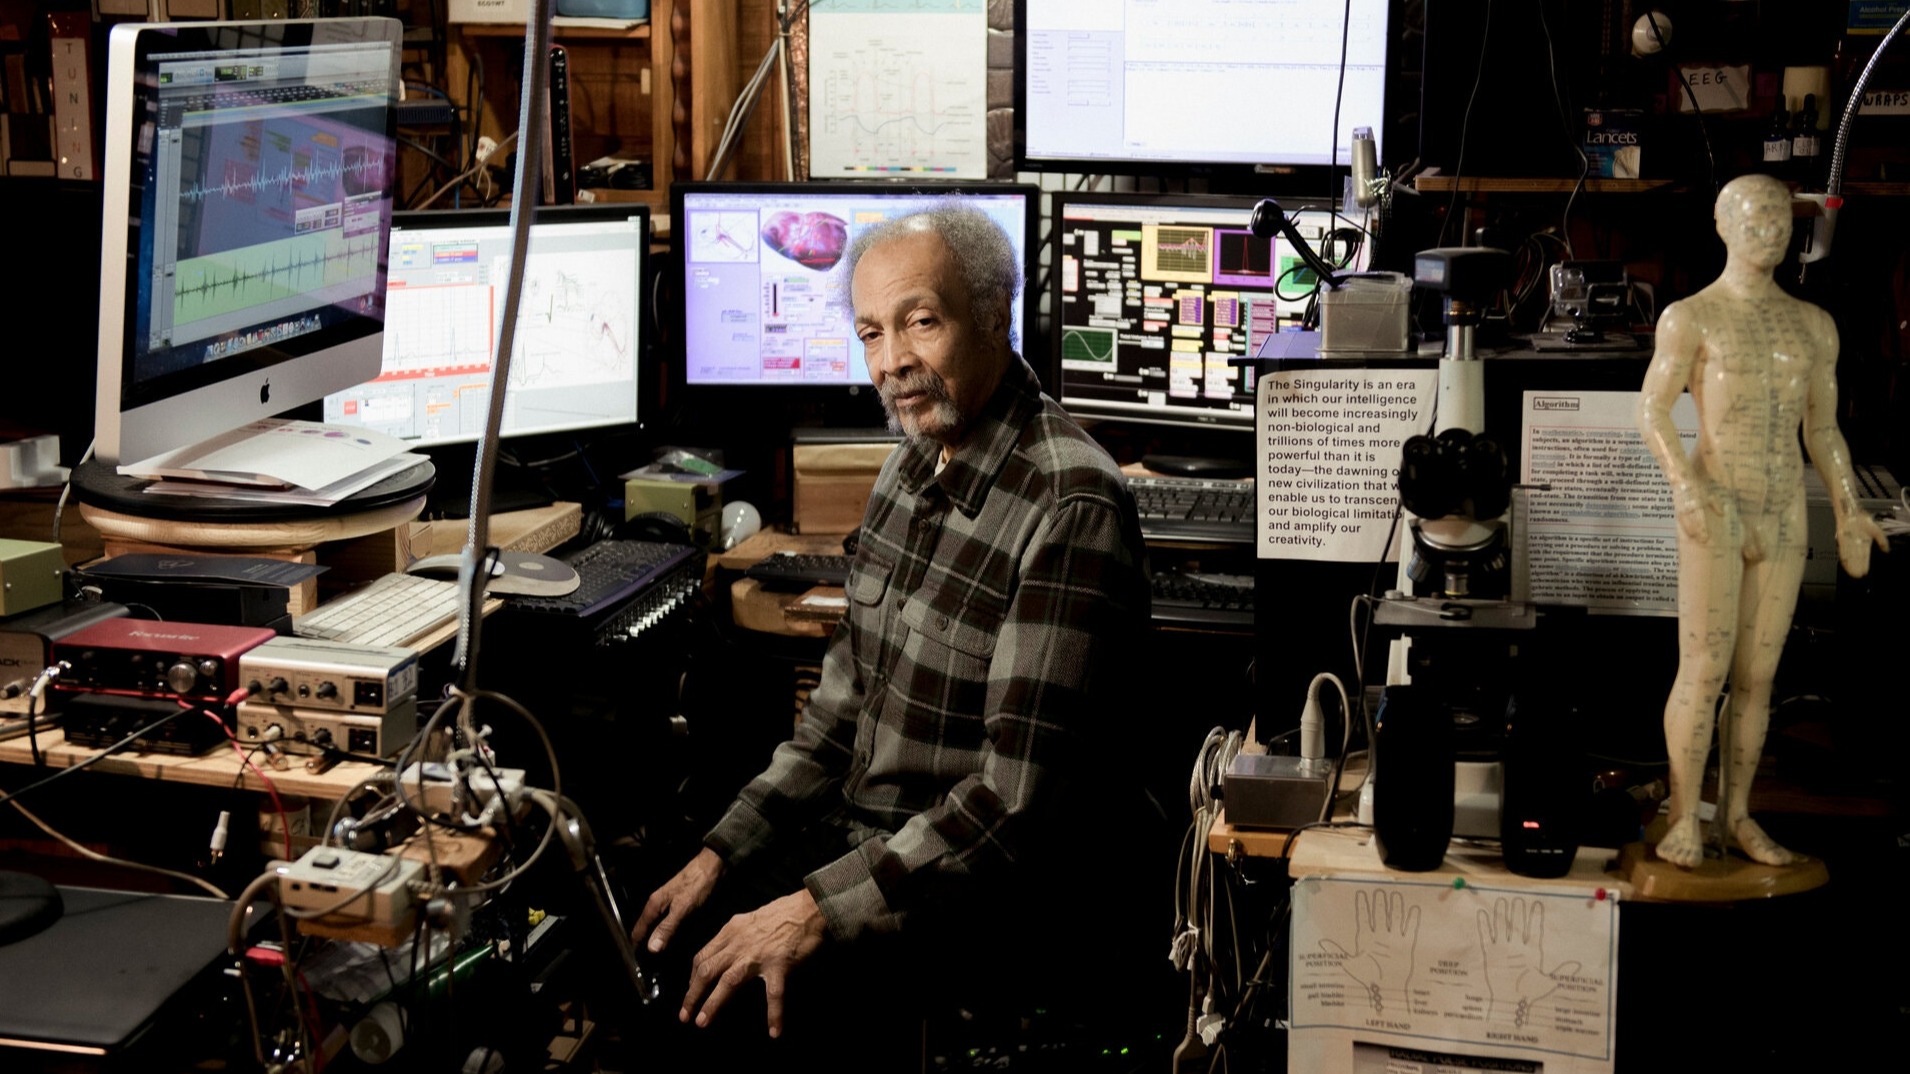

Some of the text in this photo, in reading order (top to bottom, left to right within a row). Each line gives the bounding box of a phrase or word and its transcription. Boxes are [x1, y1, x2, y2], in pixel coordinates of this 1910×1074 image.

[1689, 71, 1726, 86] EEG
[1864, 94, 1908, 106] WRAPS
[64, 42, 83, 178] TUNING
[1587, 130, 1638, 144] Lancets
[1268, 380, 1289, 390] The
[1294, 379, 1359, 392] Singularity
[1364, 379, 1373, 389] is
[1268, 395, 1278, 403] in
[1282, 393, 1317, 403] which
[1347, 394, 1416, 406] intelligence
[1536, 400, 1579, 410] Algorithm
[1268, 408, 1418, 421] will become increasingly
[1268, 422, 1380, 434] non-biological and
[1268, 436, 1400, 447] trillions of times more
[1269, 450, 1375, 462] powerful than it is
[1337, 466, 1387, 478] dawning
[1269, 480, 1292, 488] new
[1296, 479, 1359, 490] civilization
[1364, 481, 1387, 490] that
[1269, 493, 1307, 502] enable
[1329, 495, 1340, 503] to
[1345, 495, 1398, 505] transcen
[1292, 507, 1349, 520] biological
[1354, 508, 1403, 519] limitatio
[1269, 521, 1361, 534] and amplify our
[1269, 535, 1325, 548] creativity.
[1366, 1019, 1411, 1030] LEFT HAND
